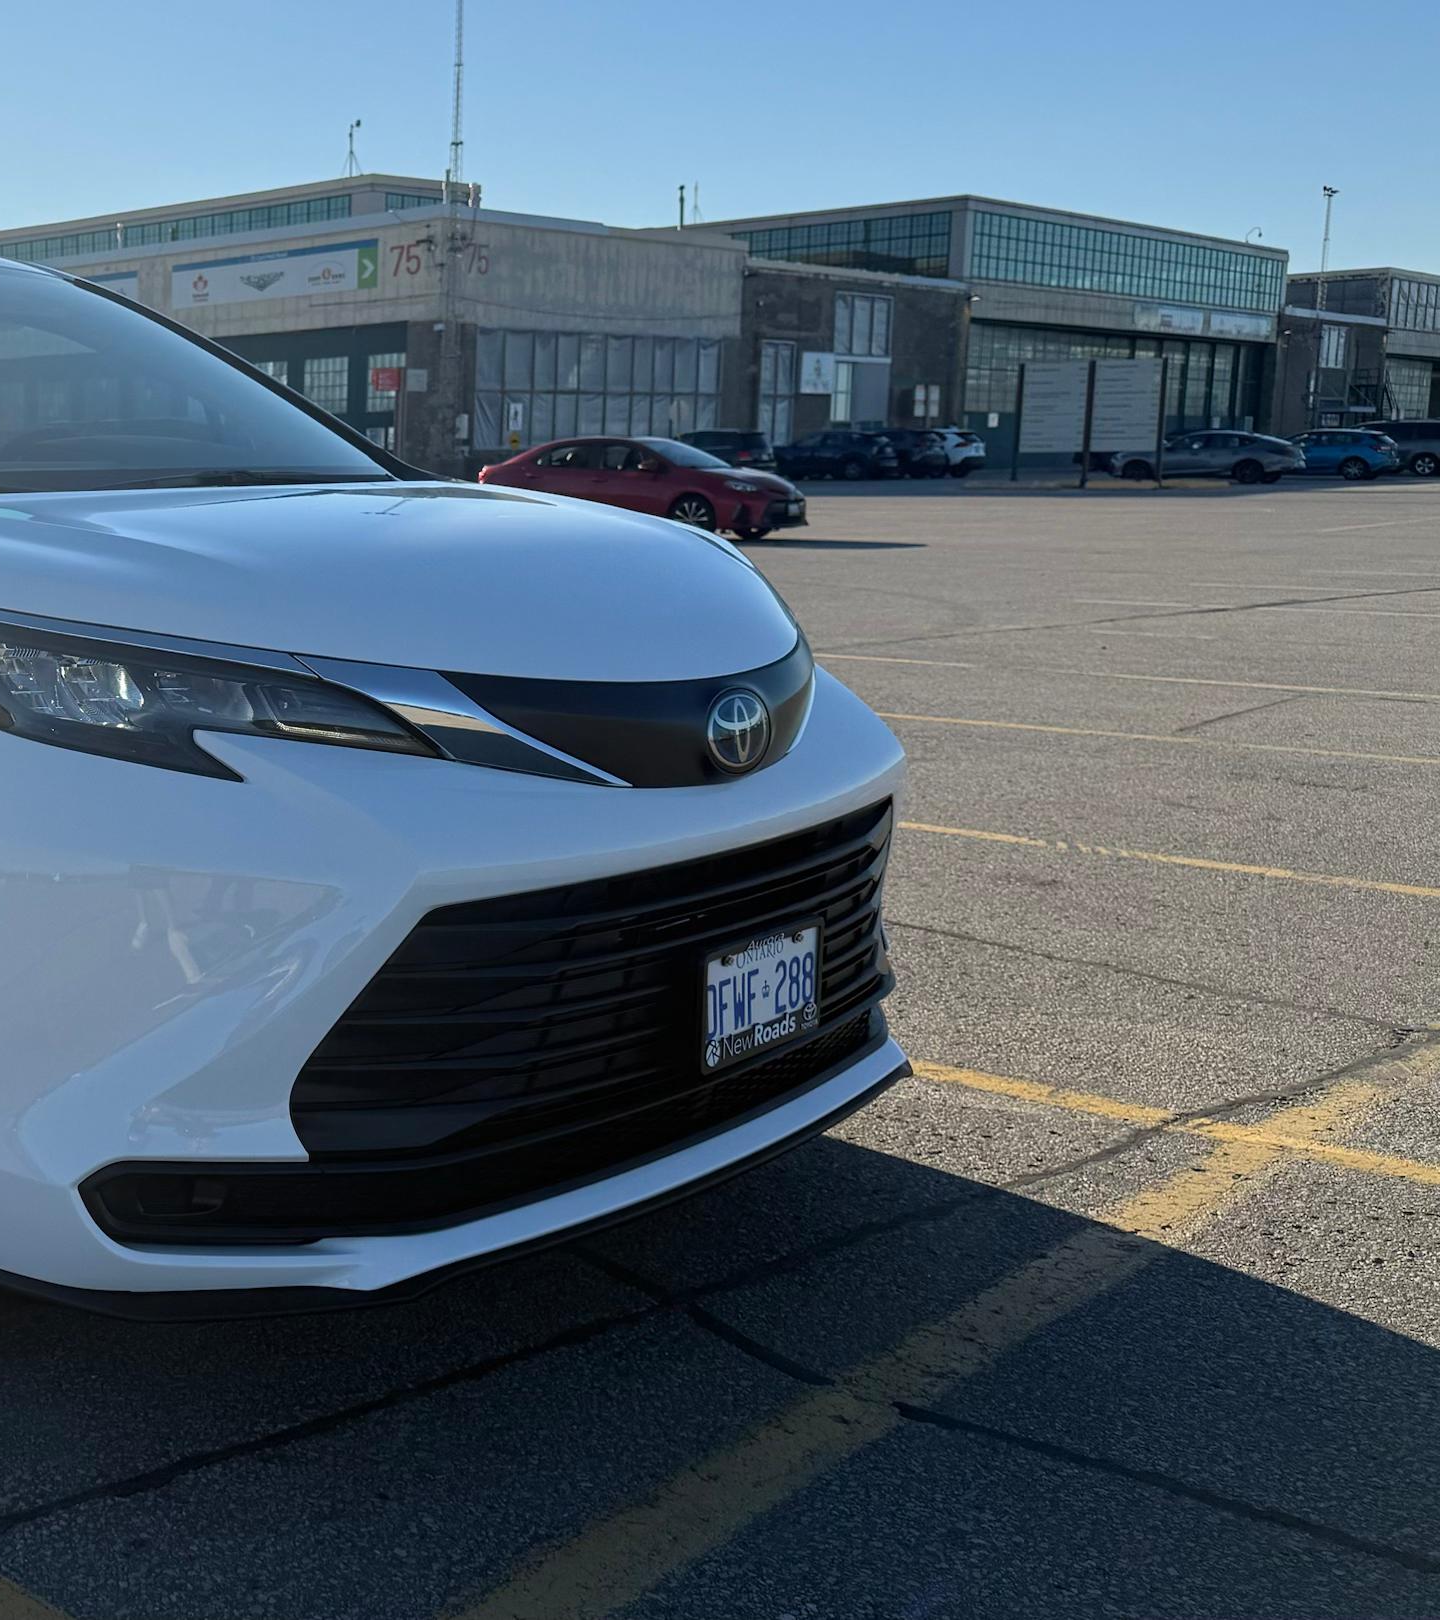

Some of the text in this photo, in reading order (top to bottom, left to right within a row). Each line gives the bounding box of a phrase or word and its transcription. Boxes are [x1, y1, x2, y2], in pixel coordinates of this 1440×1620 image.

[389, 243, 422, 277] 75
[463, 242, 490, 275] 75
[736, 939, 784, 969] ONTARIO
[775, 951, 815, 1015] 288
[722, 1013, 796, 1060] NewRoads
